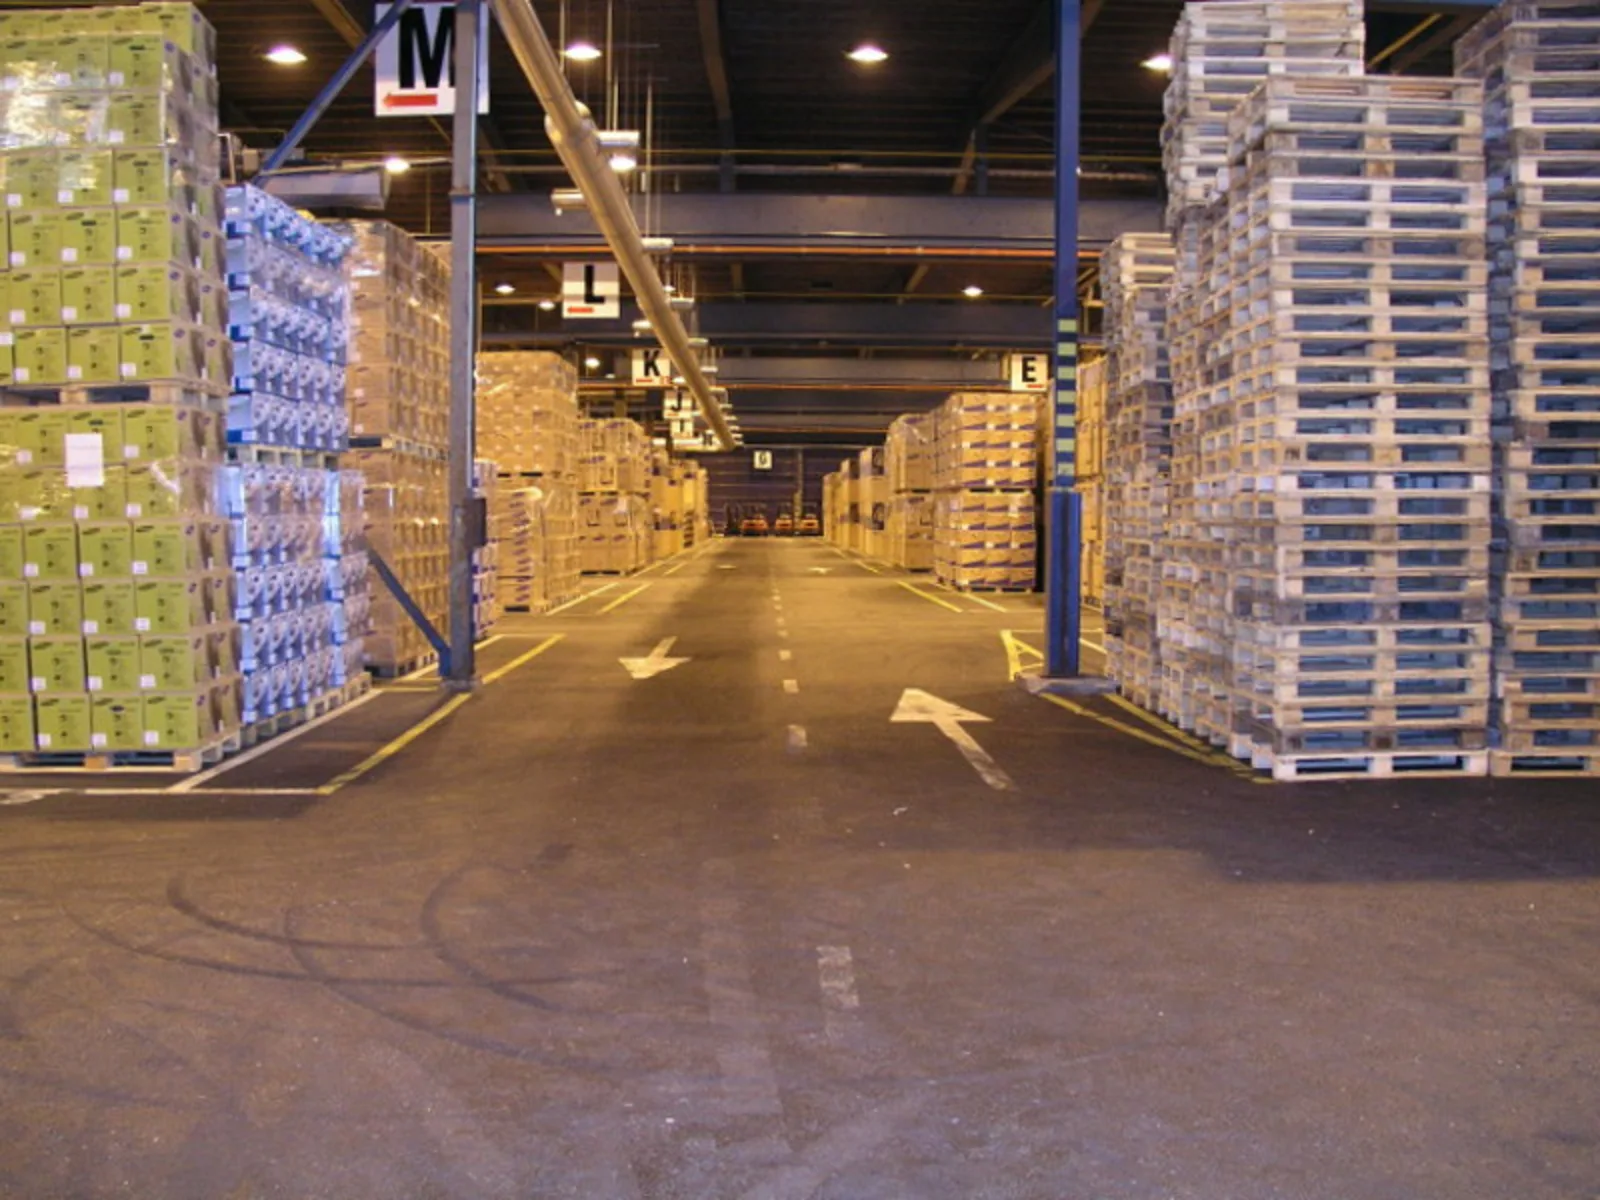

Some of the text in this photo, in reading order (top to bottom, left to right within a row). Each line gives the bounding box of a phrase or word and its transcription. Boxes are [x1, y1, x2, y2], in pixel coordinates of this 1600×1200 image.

[399, 7, 456, 88] M
[584, 265, 605, 304] L
[643, 350, 661, 377] K
[1022, 356, 1036, 382] E
[671, 391, 682, 412] J
